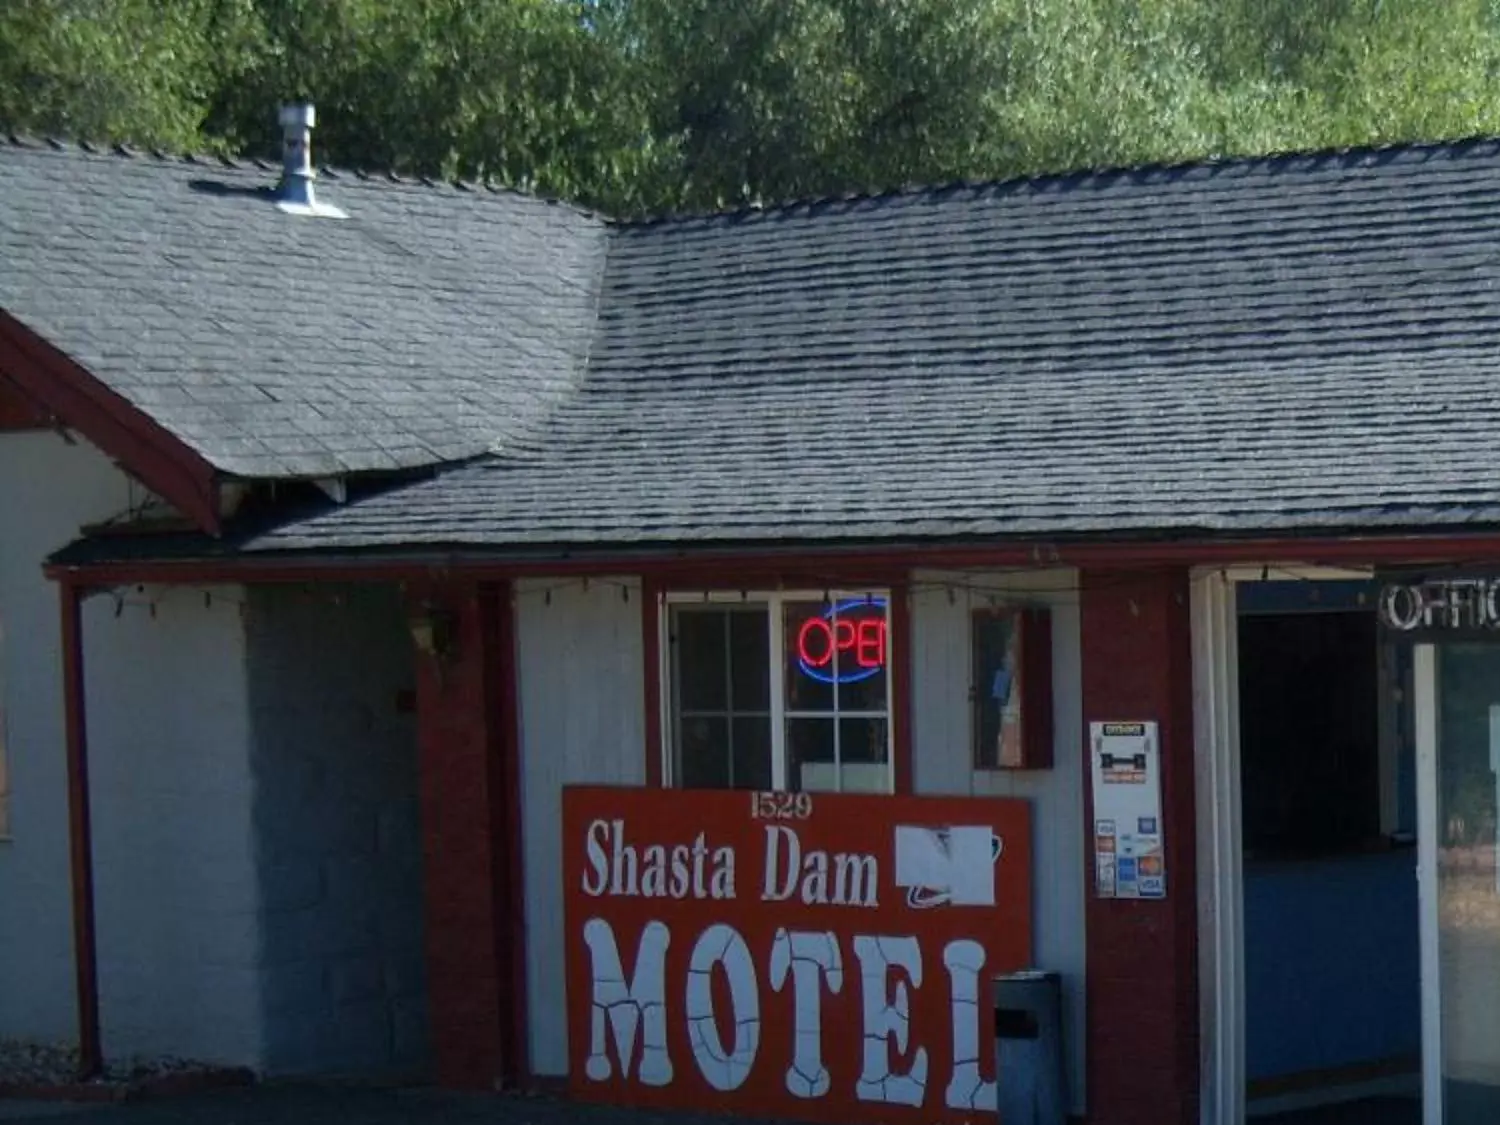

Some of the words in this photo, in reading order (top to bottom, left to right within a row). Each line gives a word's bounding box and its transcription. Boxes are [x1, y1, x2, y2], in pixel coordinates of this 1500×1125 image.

[752, 791, 812, 819] 1529
[582, 819, 737, 898] Shasta
[760, 825, 879, 907] Dam
[583, 917, 998, 1111] MOTEL
